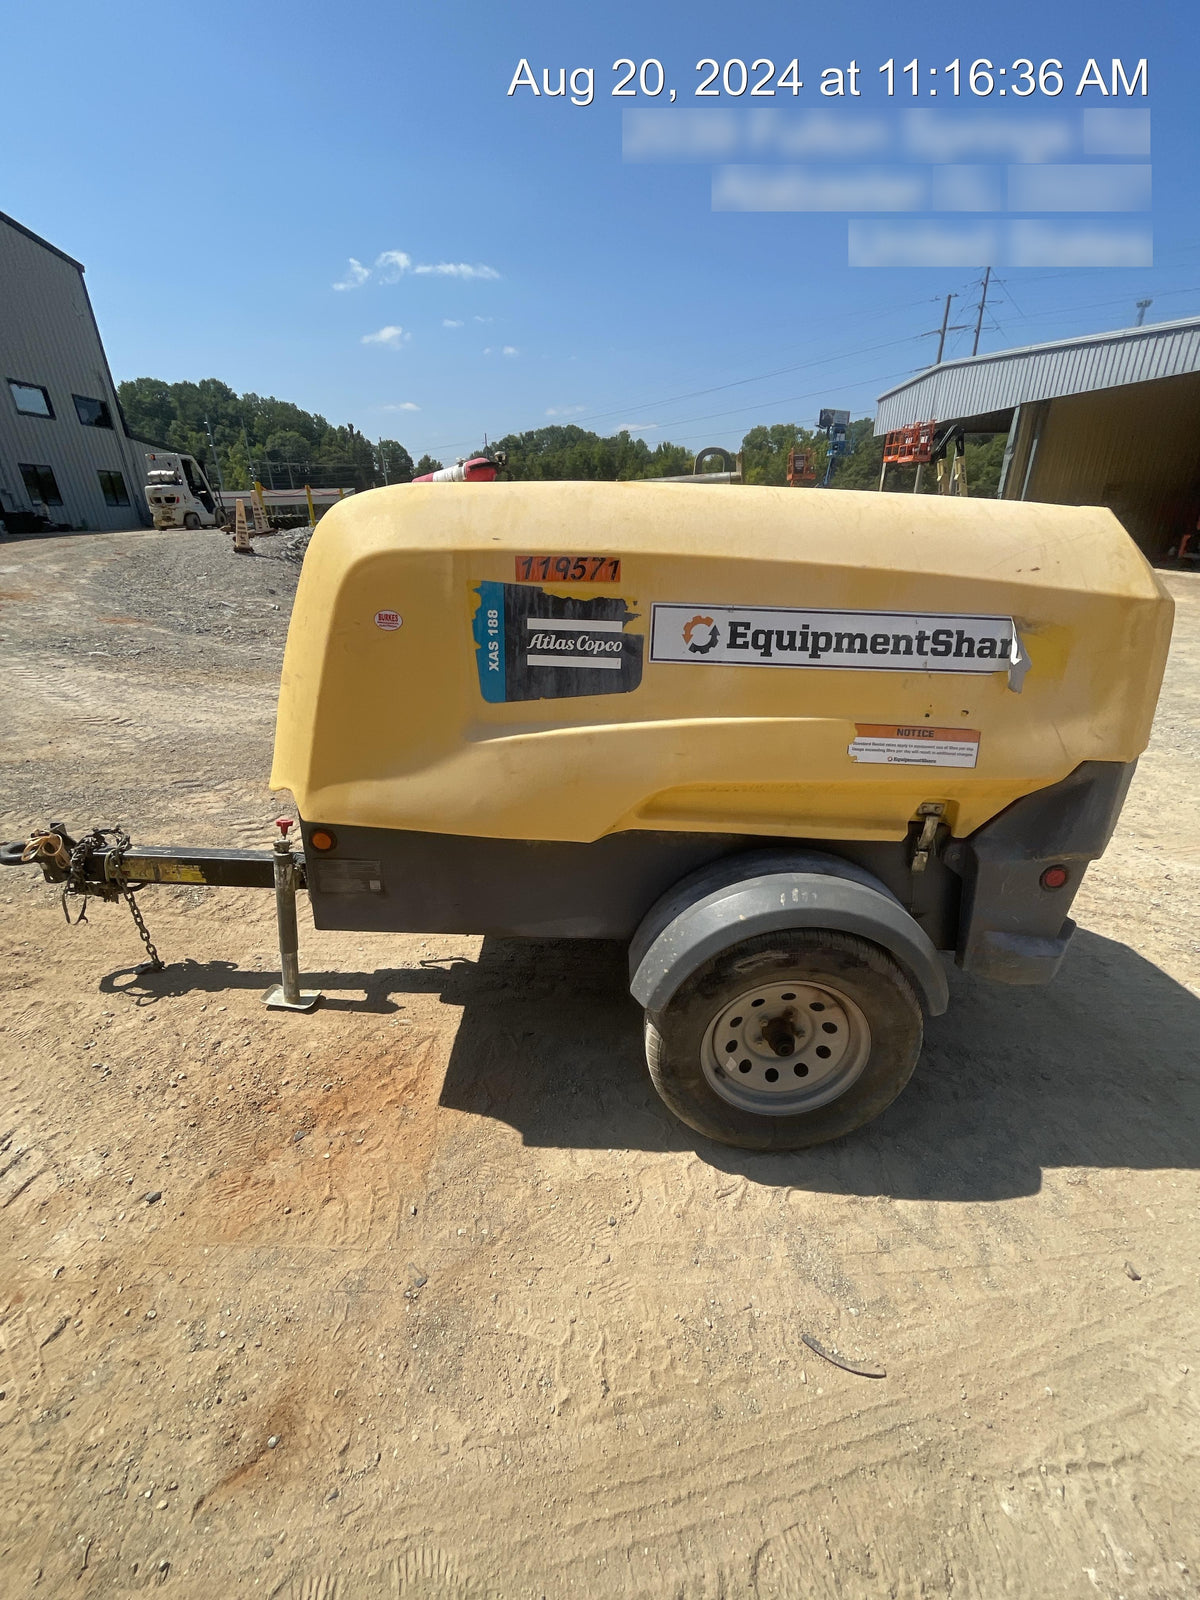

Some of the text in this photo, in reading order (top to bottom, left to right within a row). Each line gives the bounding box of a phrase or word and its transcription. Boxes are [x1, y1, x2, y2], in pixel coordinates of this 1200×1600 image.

[521, 556, 620, 581] 119571
[487, 609, 500, 672] XAS 188
[527, 633, 622, 654] Atlas Copco
[896, 728, 935, 738] NOTICE
